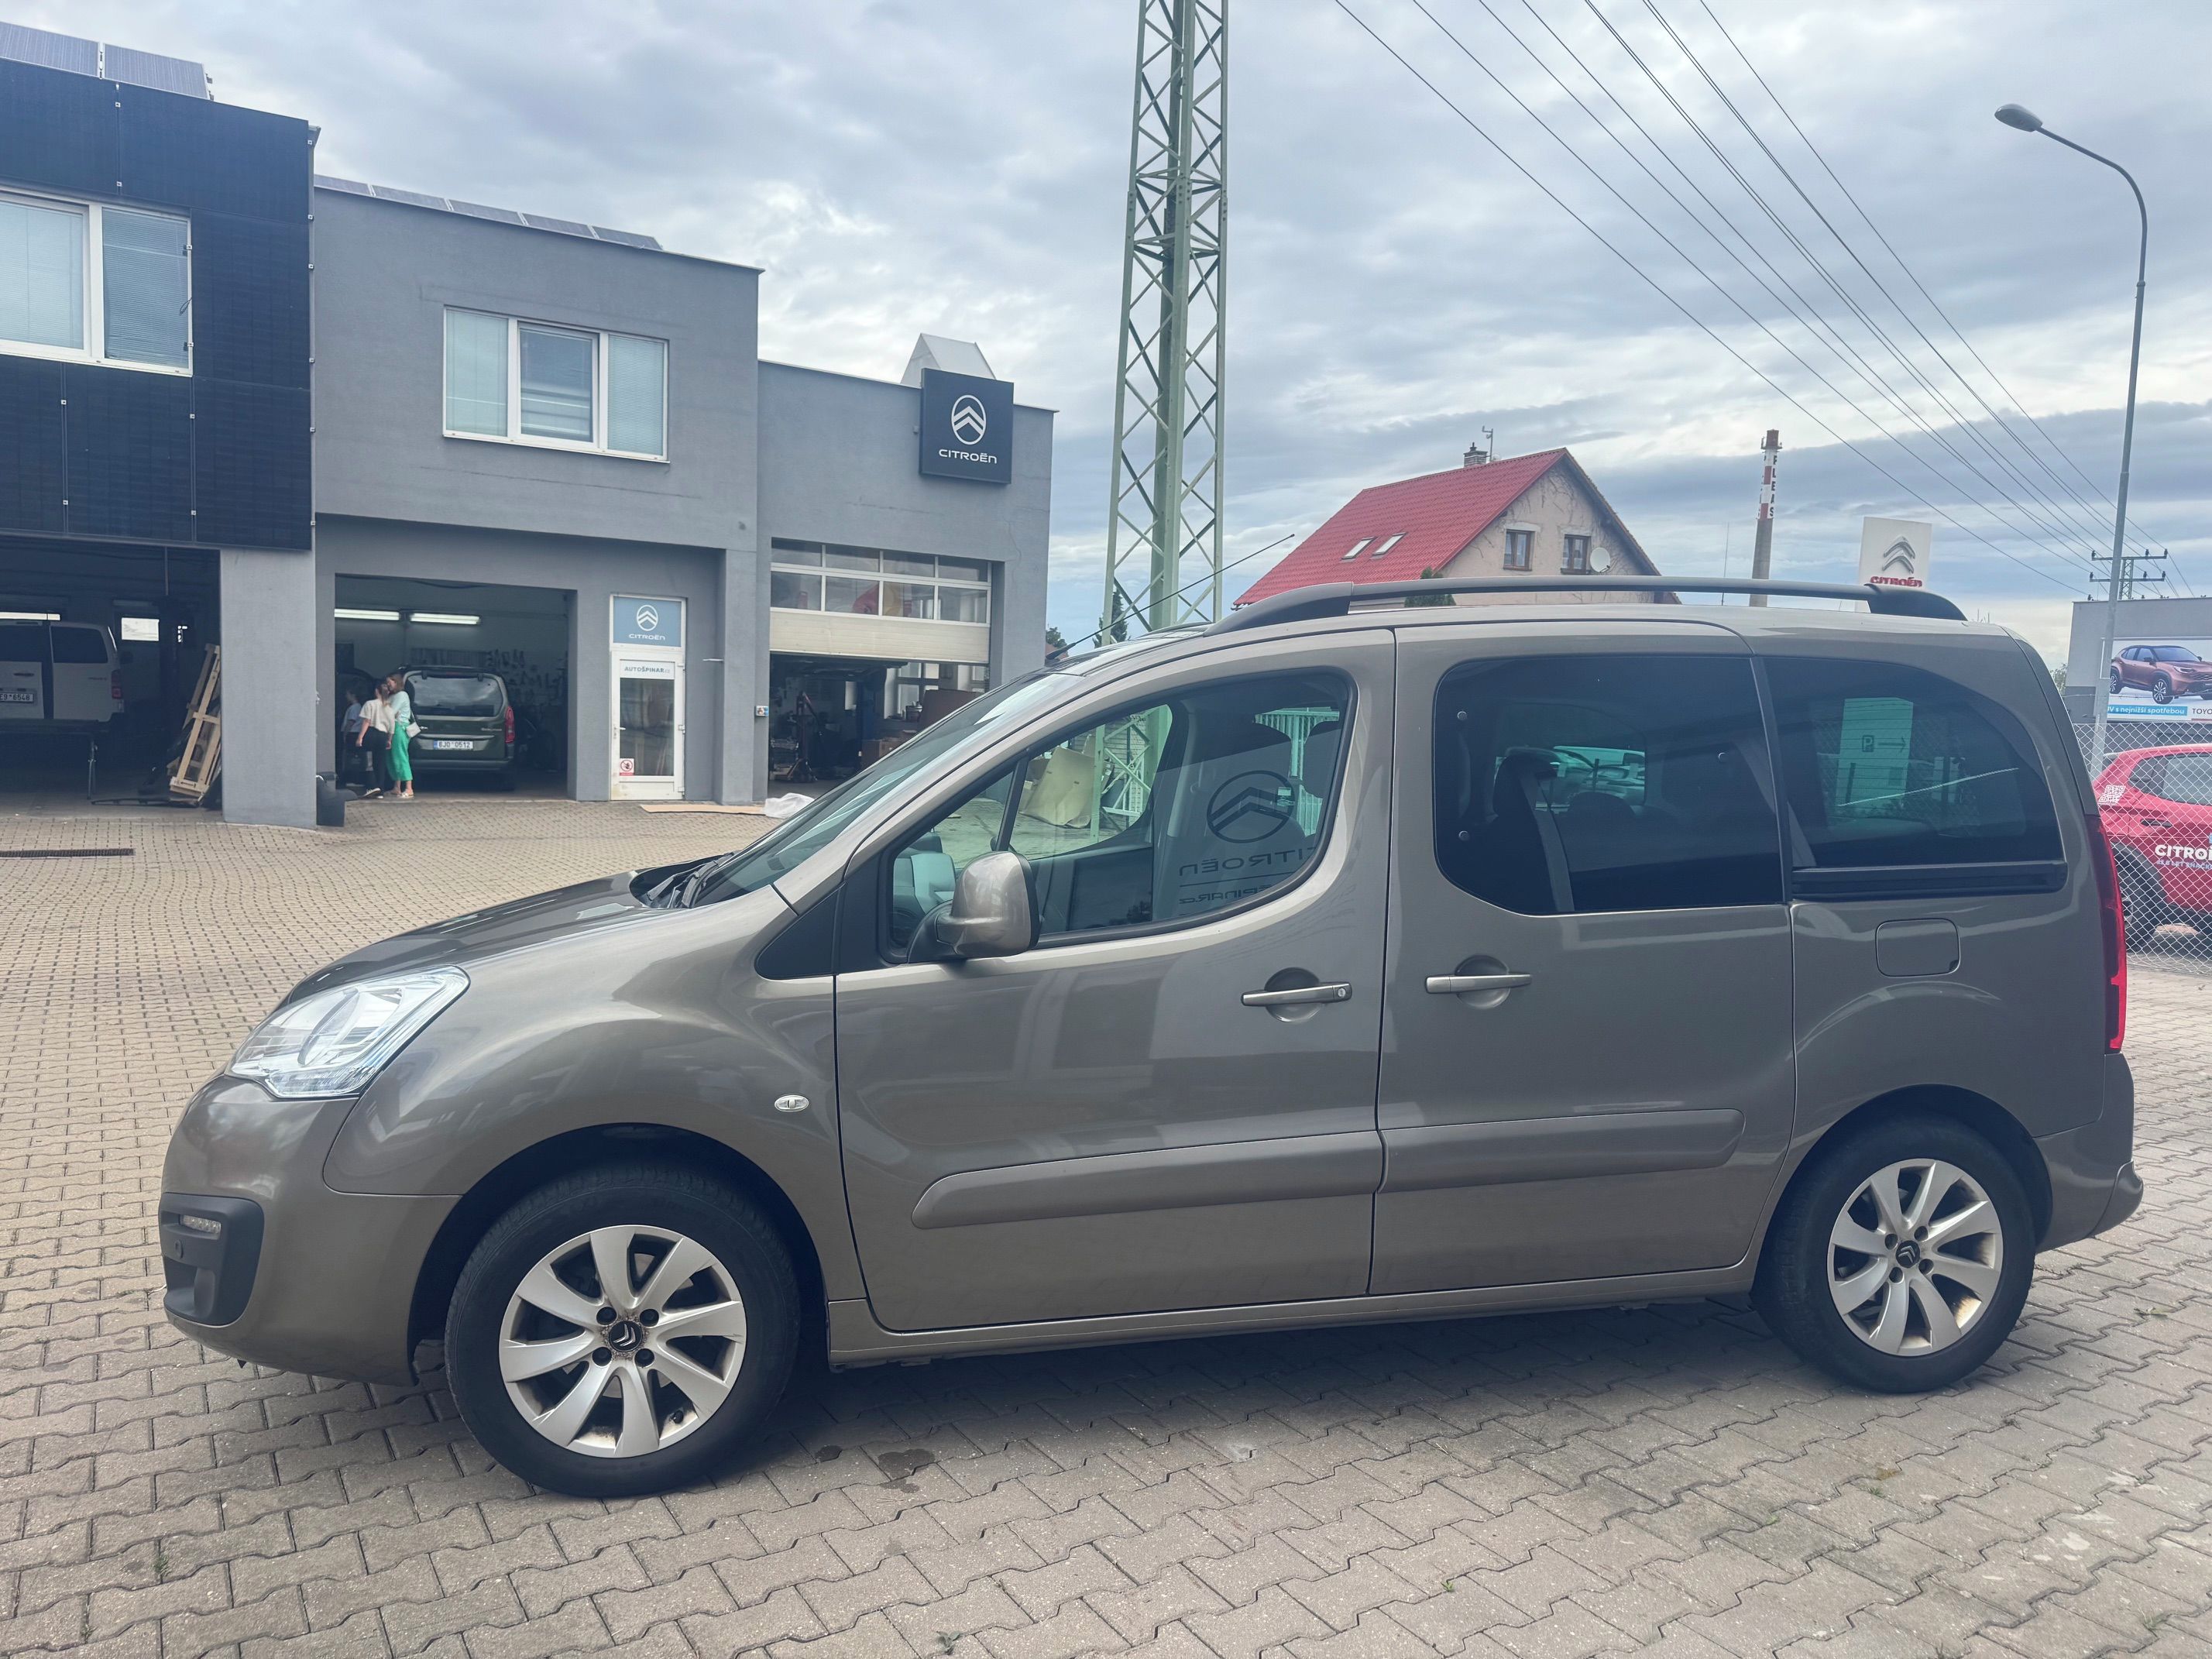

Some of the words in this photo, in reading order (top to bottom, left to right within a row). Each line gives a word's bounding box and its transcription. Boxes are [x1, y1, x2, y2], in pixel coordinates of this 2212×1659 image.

[939, 448, 997, 464] CITROËN
[1870, 576, 1922, 588] CITROËN
[2147, 706, 2184, 715] spotřebou
[1863, 736, 1873, 751] P
